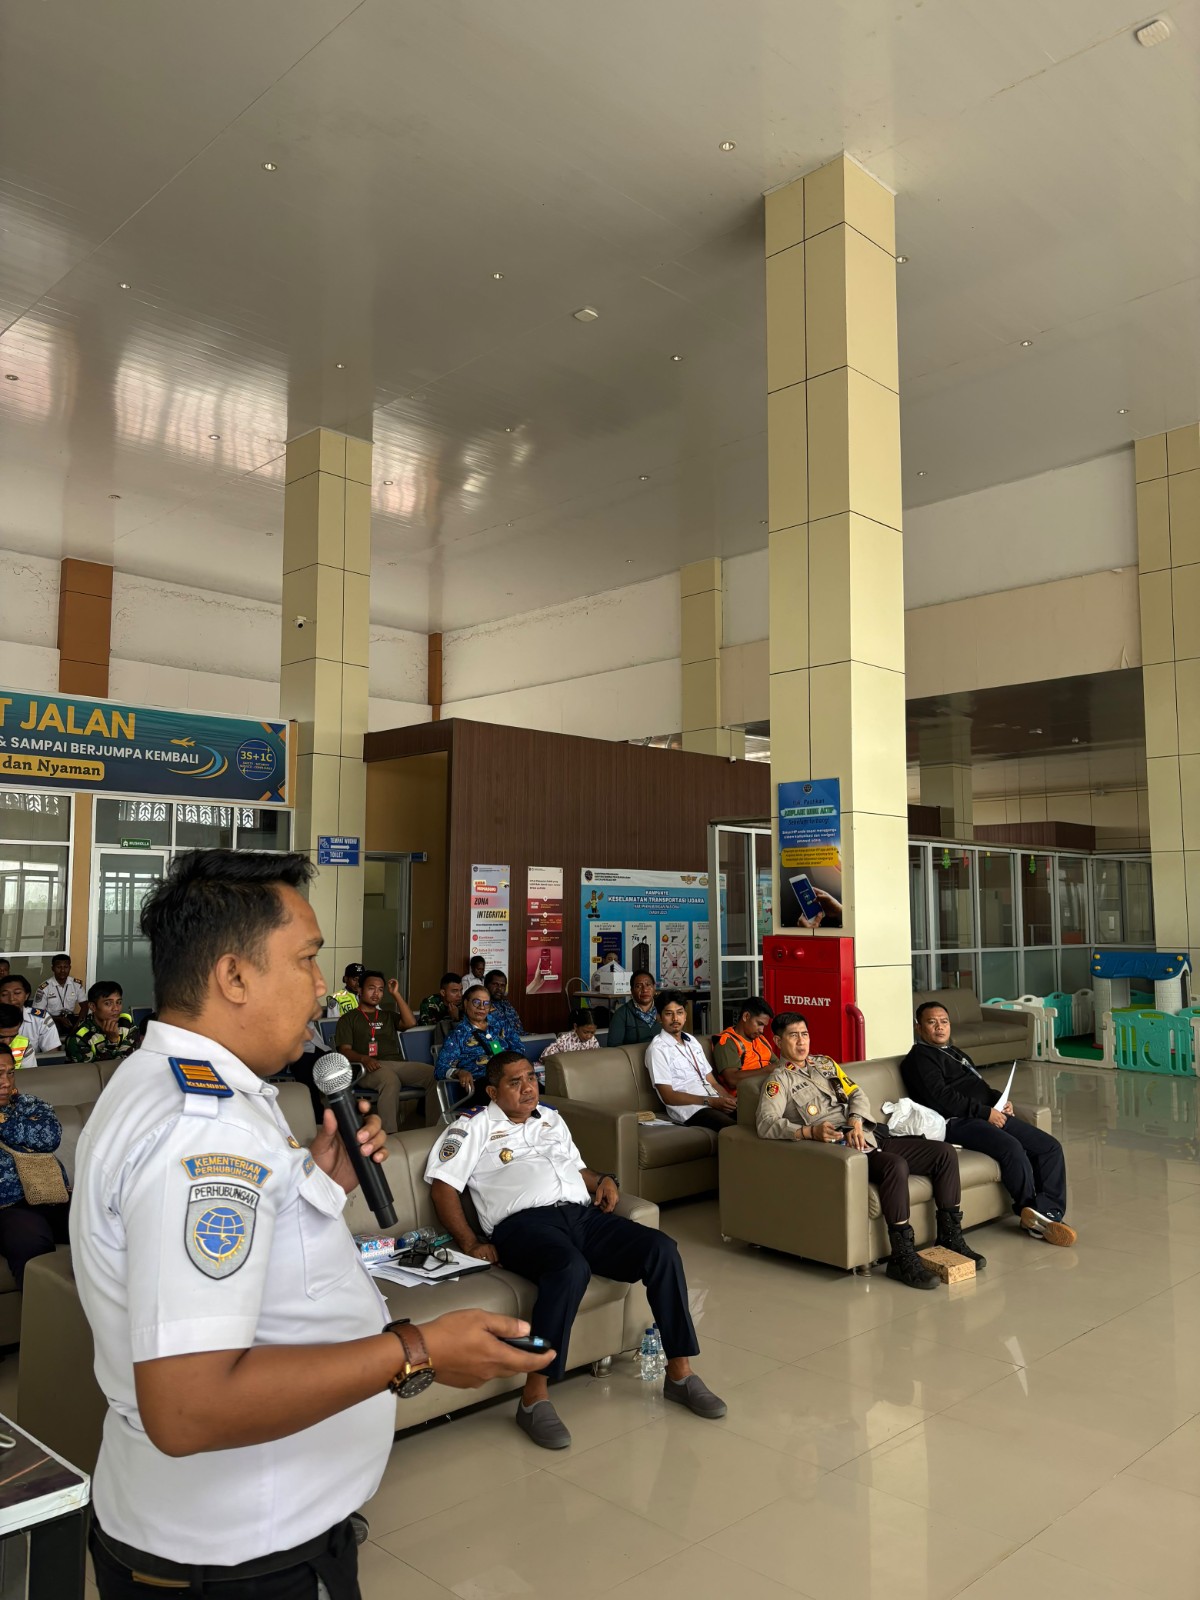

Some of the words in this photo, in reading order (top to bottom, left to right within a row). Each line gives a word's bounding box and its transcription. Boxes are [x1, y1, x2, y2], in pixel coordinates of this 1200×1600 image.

[20, 701, 136, 740] JALAN
[10, 736, 68, 753] SAMPAI
[70, 742, 142, 760] BERJUMPA
[145, 749, 199, 764] KEMBALI
[240, 750, 273, 763] 3S+1C
[2, 755, 33, 771] dan
[36, 758, 101, 777] Nyaman
[474, 897, 489, 906] ZONA
[476, 910, 507, 919] INTEGRITAS
[784, 995, 831, 1007] HYDRANT
[791, 1081, 809, 1094] ARIE
[194, 1156, 261, 1175] KEMENTERIAN
[195, 1165, 259, 1182] PERHUBUNGAN
[194, 1185, 256, 1205] PERHUBUNGAN
